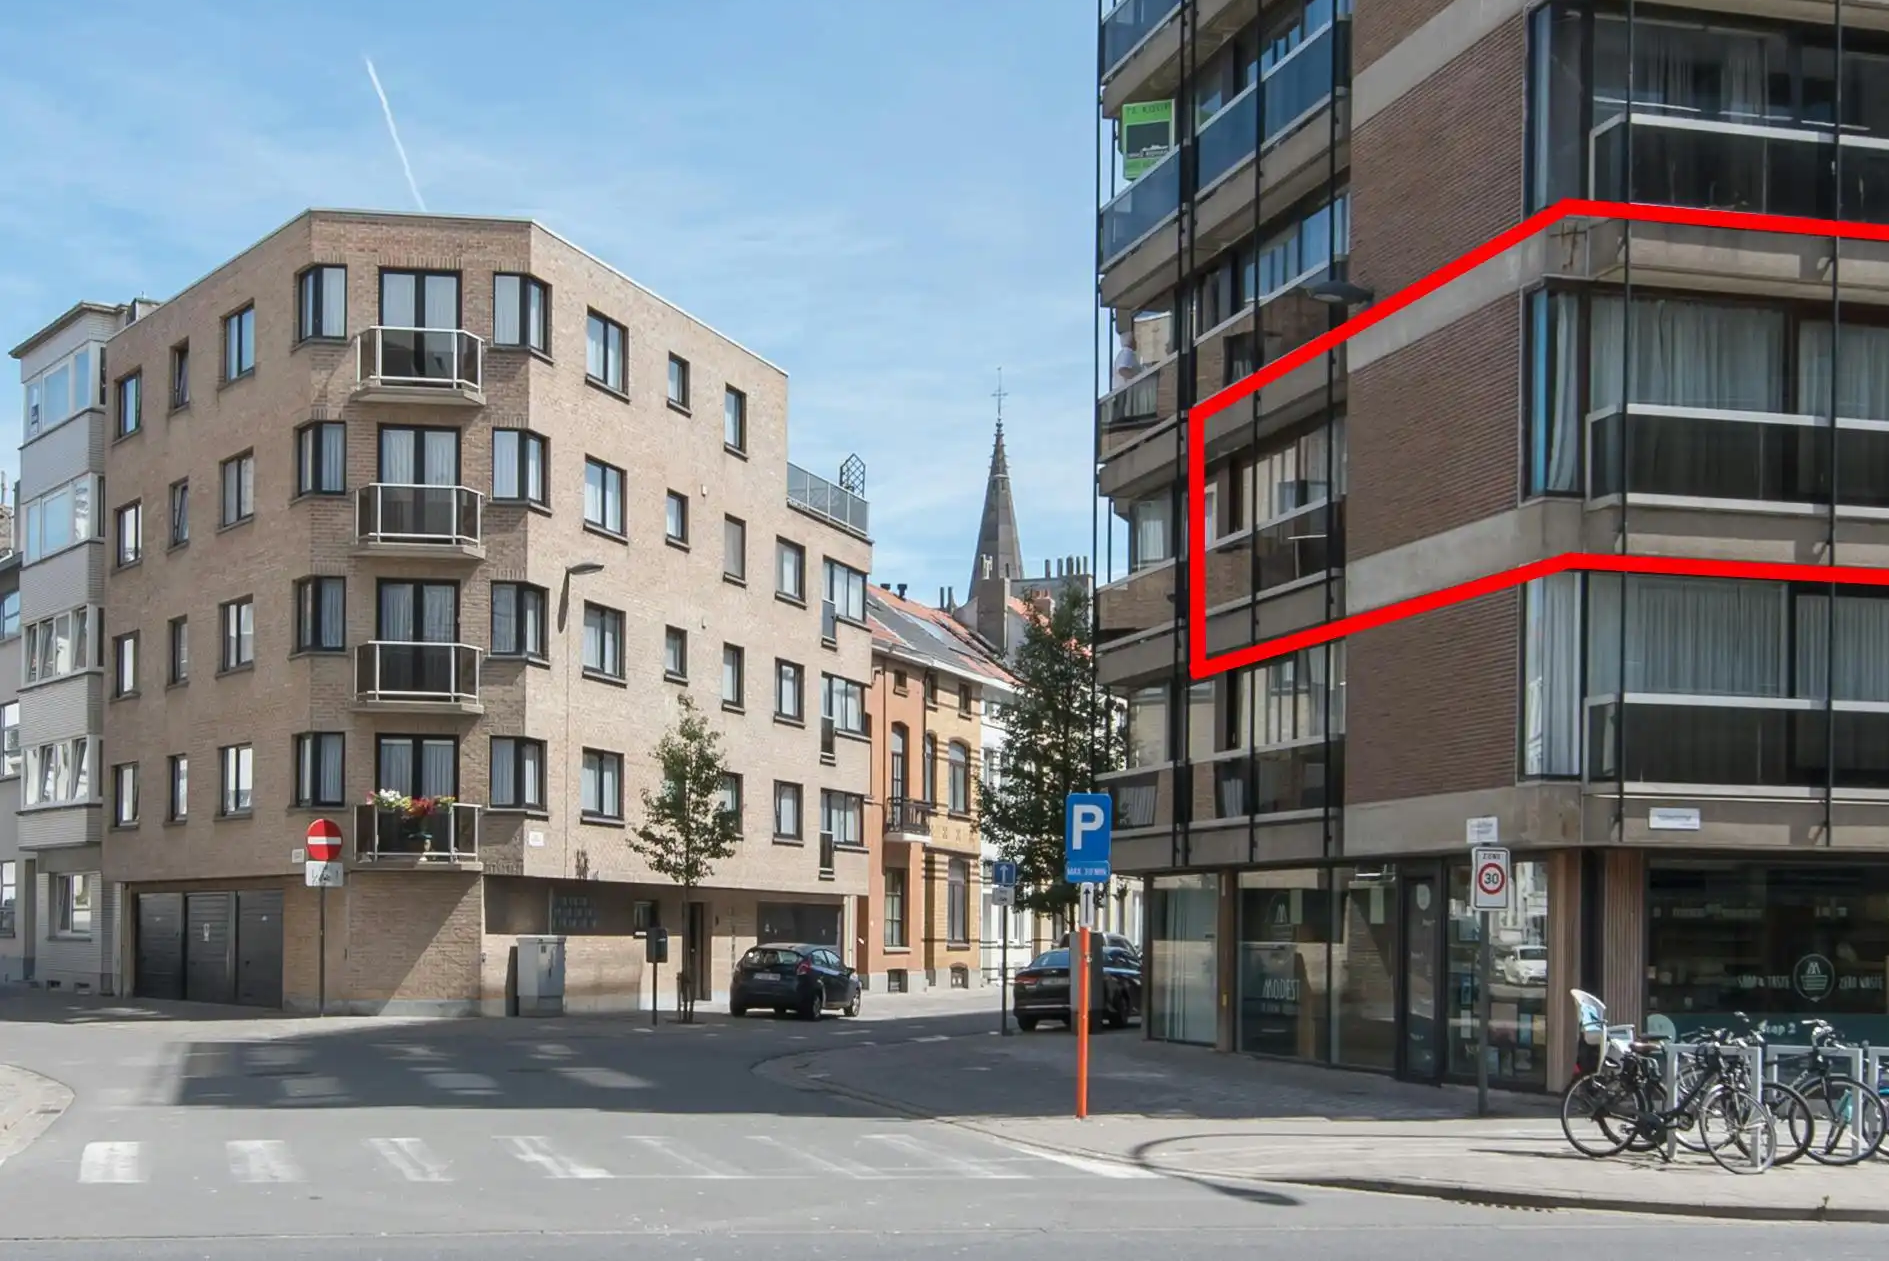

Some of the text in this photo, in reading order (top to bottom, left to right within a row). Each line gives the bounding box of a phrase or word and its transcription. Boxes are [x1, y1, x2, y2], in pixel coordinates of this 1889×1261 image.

[1072, 804, 1104, 850] P
[1484, 873, 1500, 884] 30
[1262, 978, 1300, 1001] MODEST
